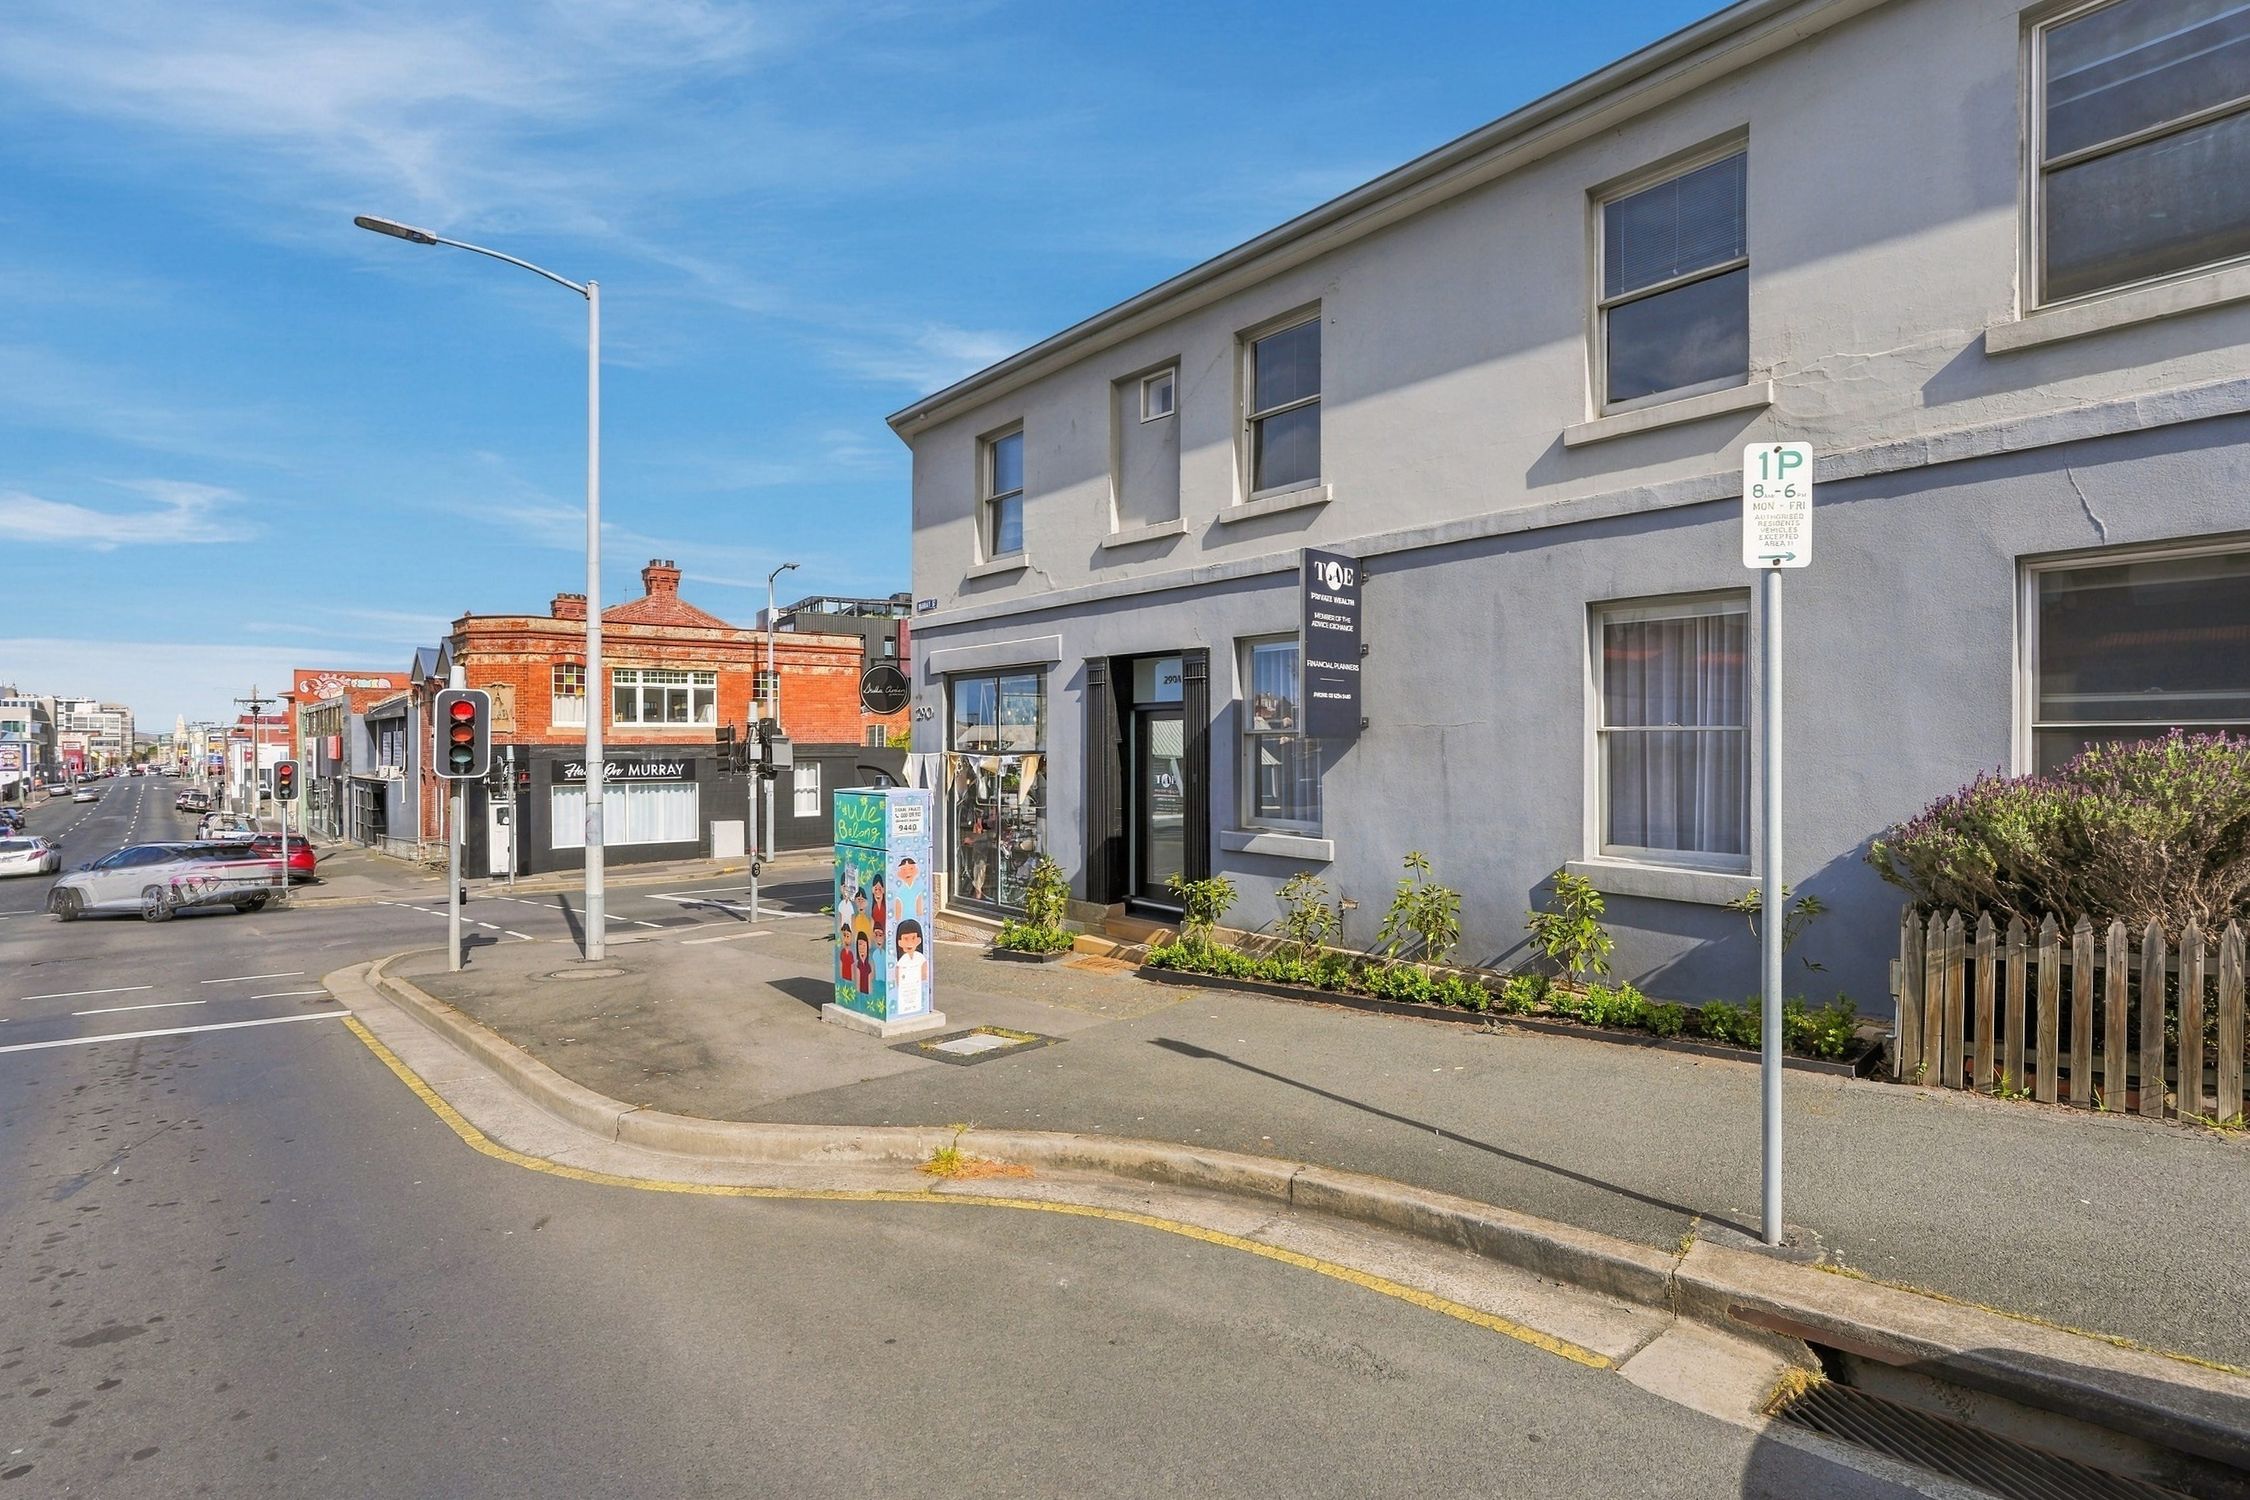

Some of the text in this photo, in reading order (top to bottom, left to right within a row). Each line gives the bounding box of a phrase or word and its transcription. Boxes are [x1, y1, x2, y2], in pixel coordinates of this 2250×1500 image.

[1759, 450, 1803, 480] 1P
[1753, 501, 1775, 511] MON
[1789, 501, 1806, 510] FRI
[1310, 592, 1355, 606] PRIVATE WEALTH
[1311, 620, 1354, 633] ADVICE EXCHANGE
[1306, 660, 1360, 671] FINANCIAL PLANNERS
[628, 763, 685, 776] MURRAY
[838, 819, 881, 843] Belong
[898, 823, 917, 831] 9440
